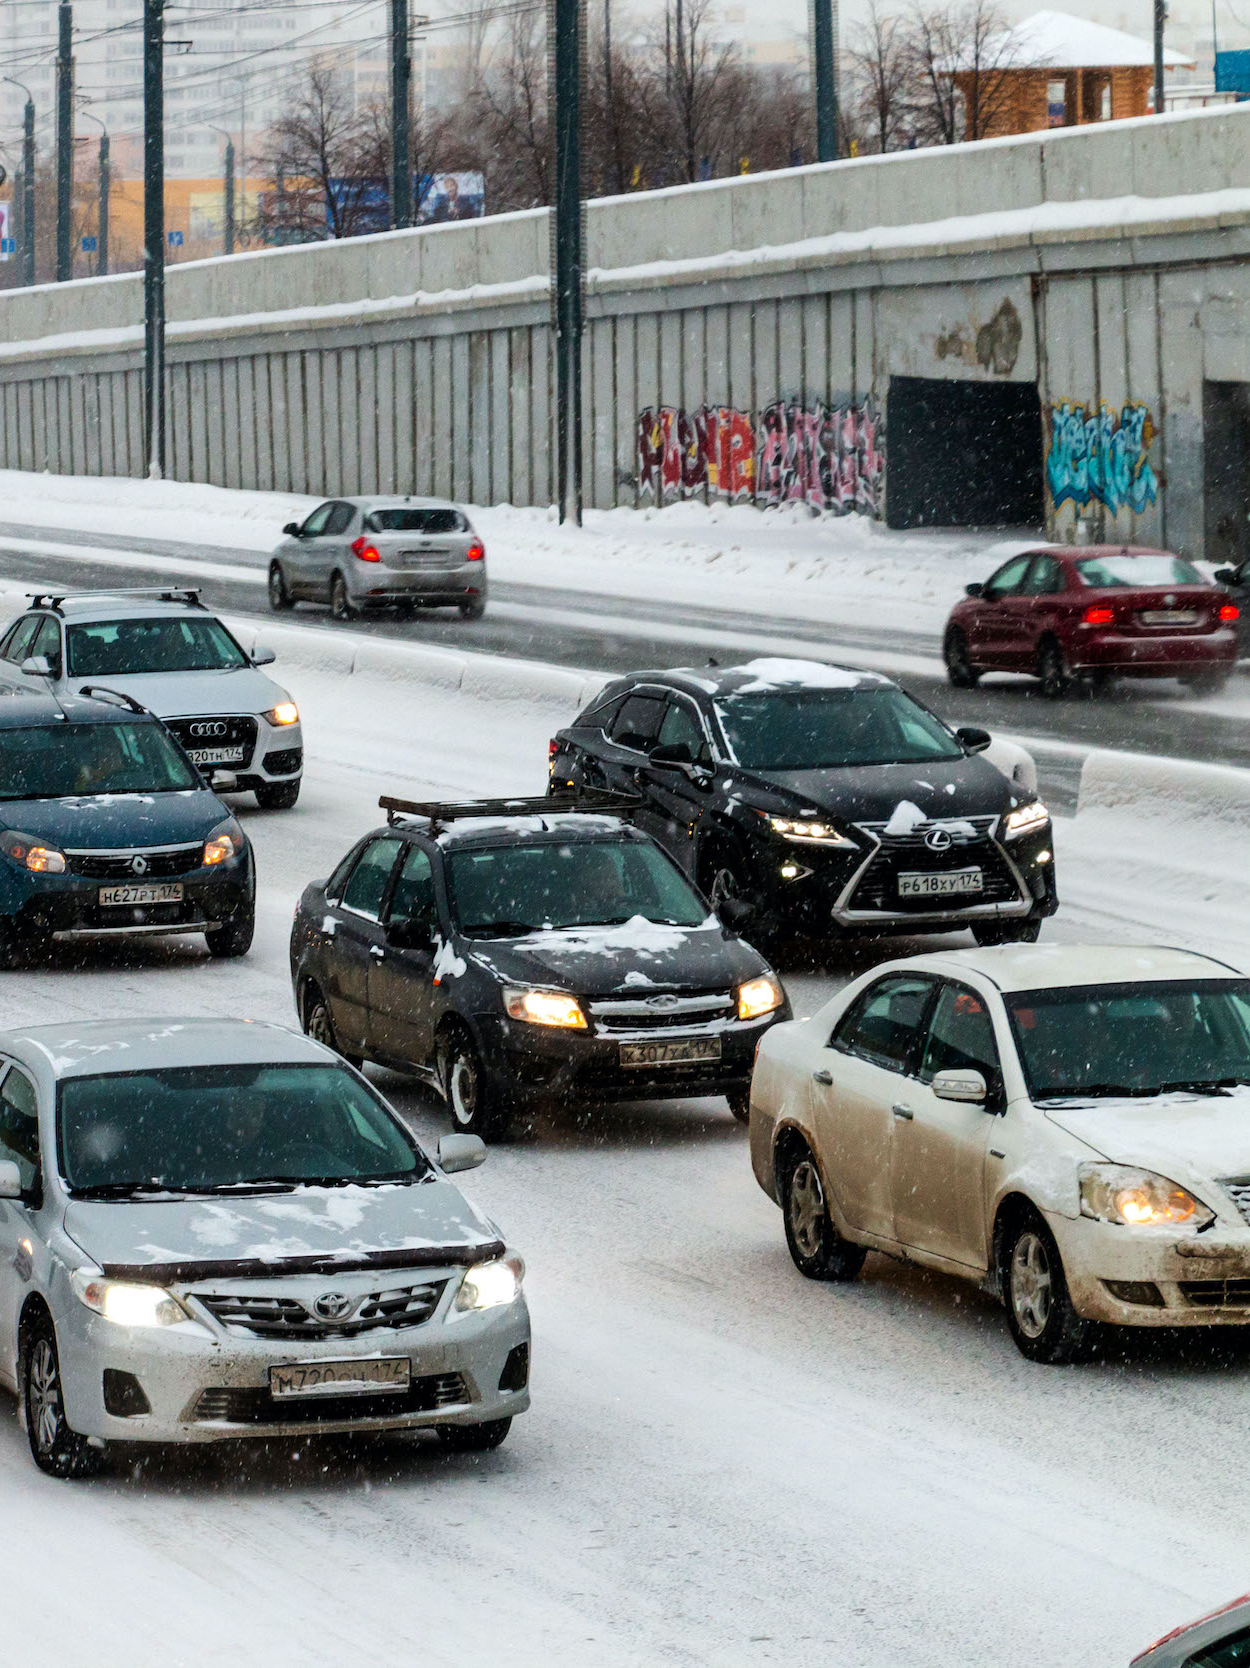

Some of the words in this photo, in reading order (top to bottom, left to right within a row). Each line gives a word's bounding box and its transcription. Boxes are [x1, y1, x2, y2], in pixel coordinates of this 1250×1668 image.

[225, 748, 243, 757] 174
[903, 876, 957, 893] Р618ХУ
[959, 874, 980, 886] 174
[104, 888, 157, 903] Н627РТ
[160, 885, 181, 899] 174
